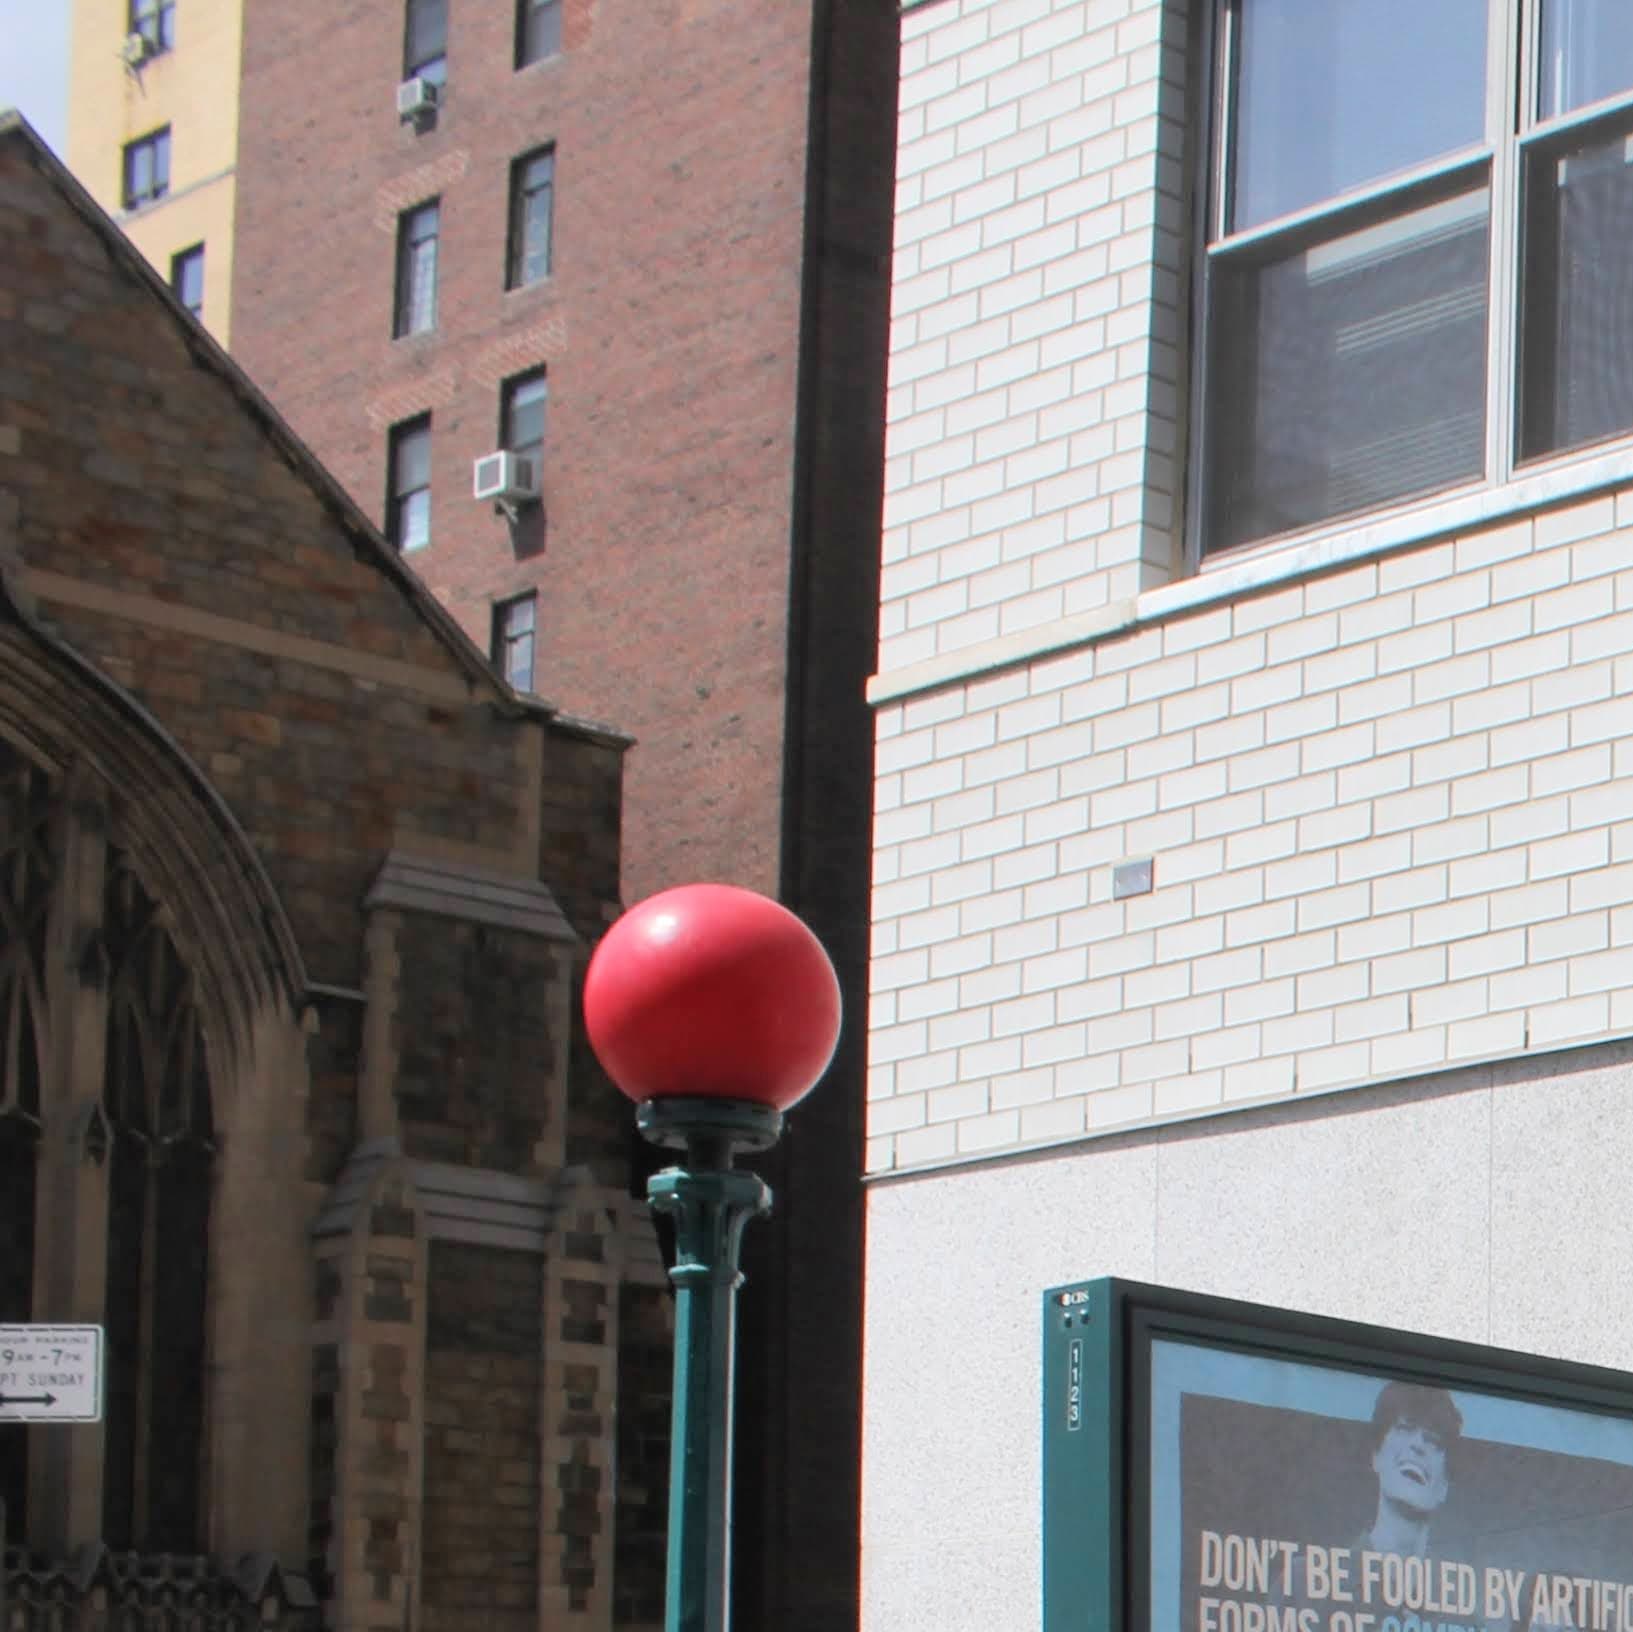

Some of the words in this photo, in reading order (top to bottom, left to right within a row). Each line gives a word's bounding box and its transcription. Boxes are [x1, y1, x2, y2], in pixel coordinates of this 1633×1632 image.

[27, 1372, 84, 1387] SUNDAY
[1070, 1347, 1079, 1421] 1123
[1201, 1530, 1298, 1597] DON'T
[1306, 1544, 1353, 1602] BE
[1362, 1550, 1476, 1616] FOOLED
[1485, 1567, 1526, 1622] BY
